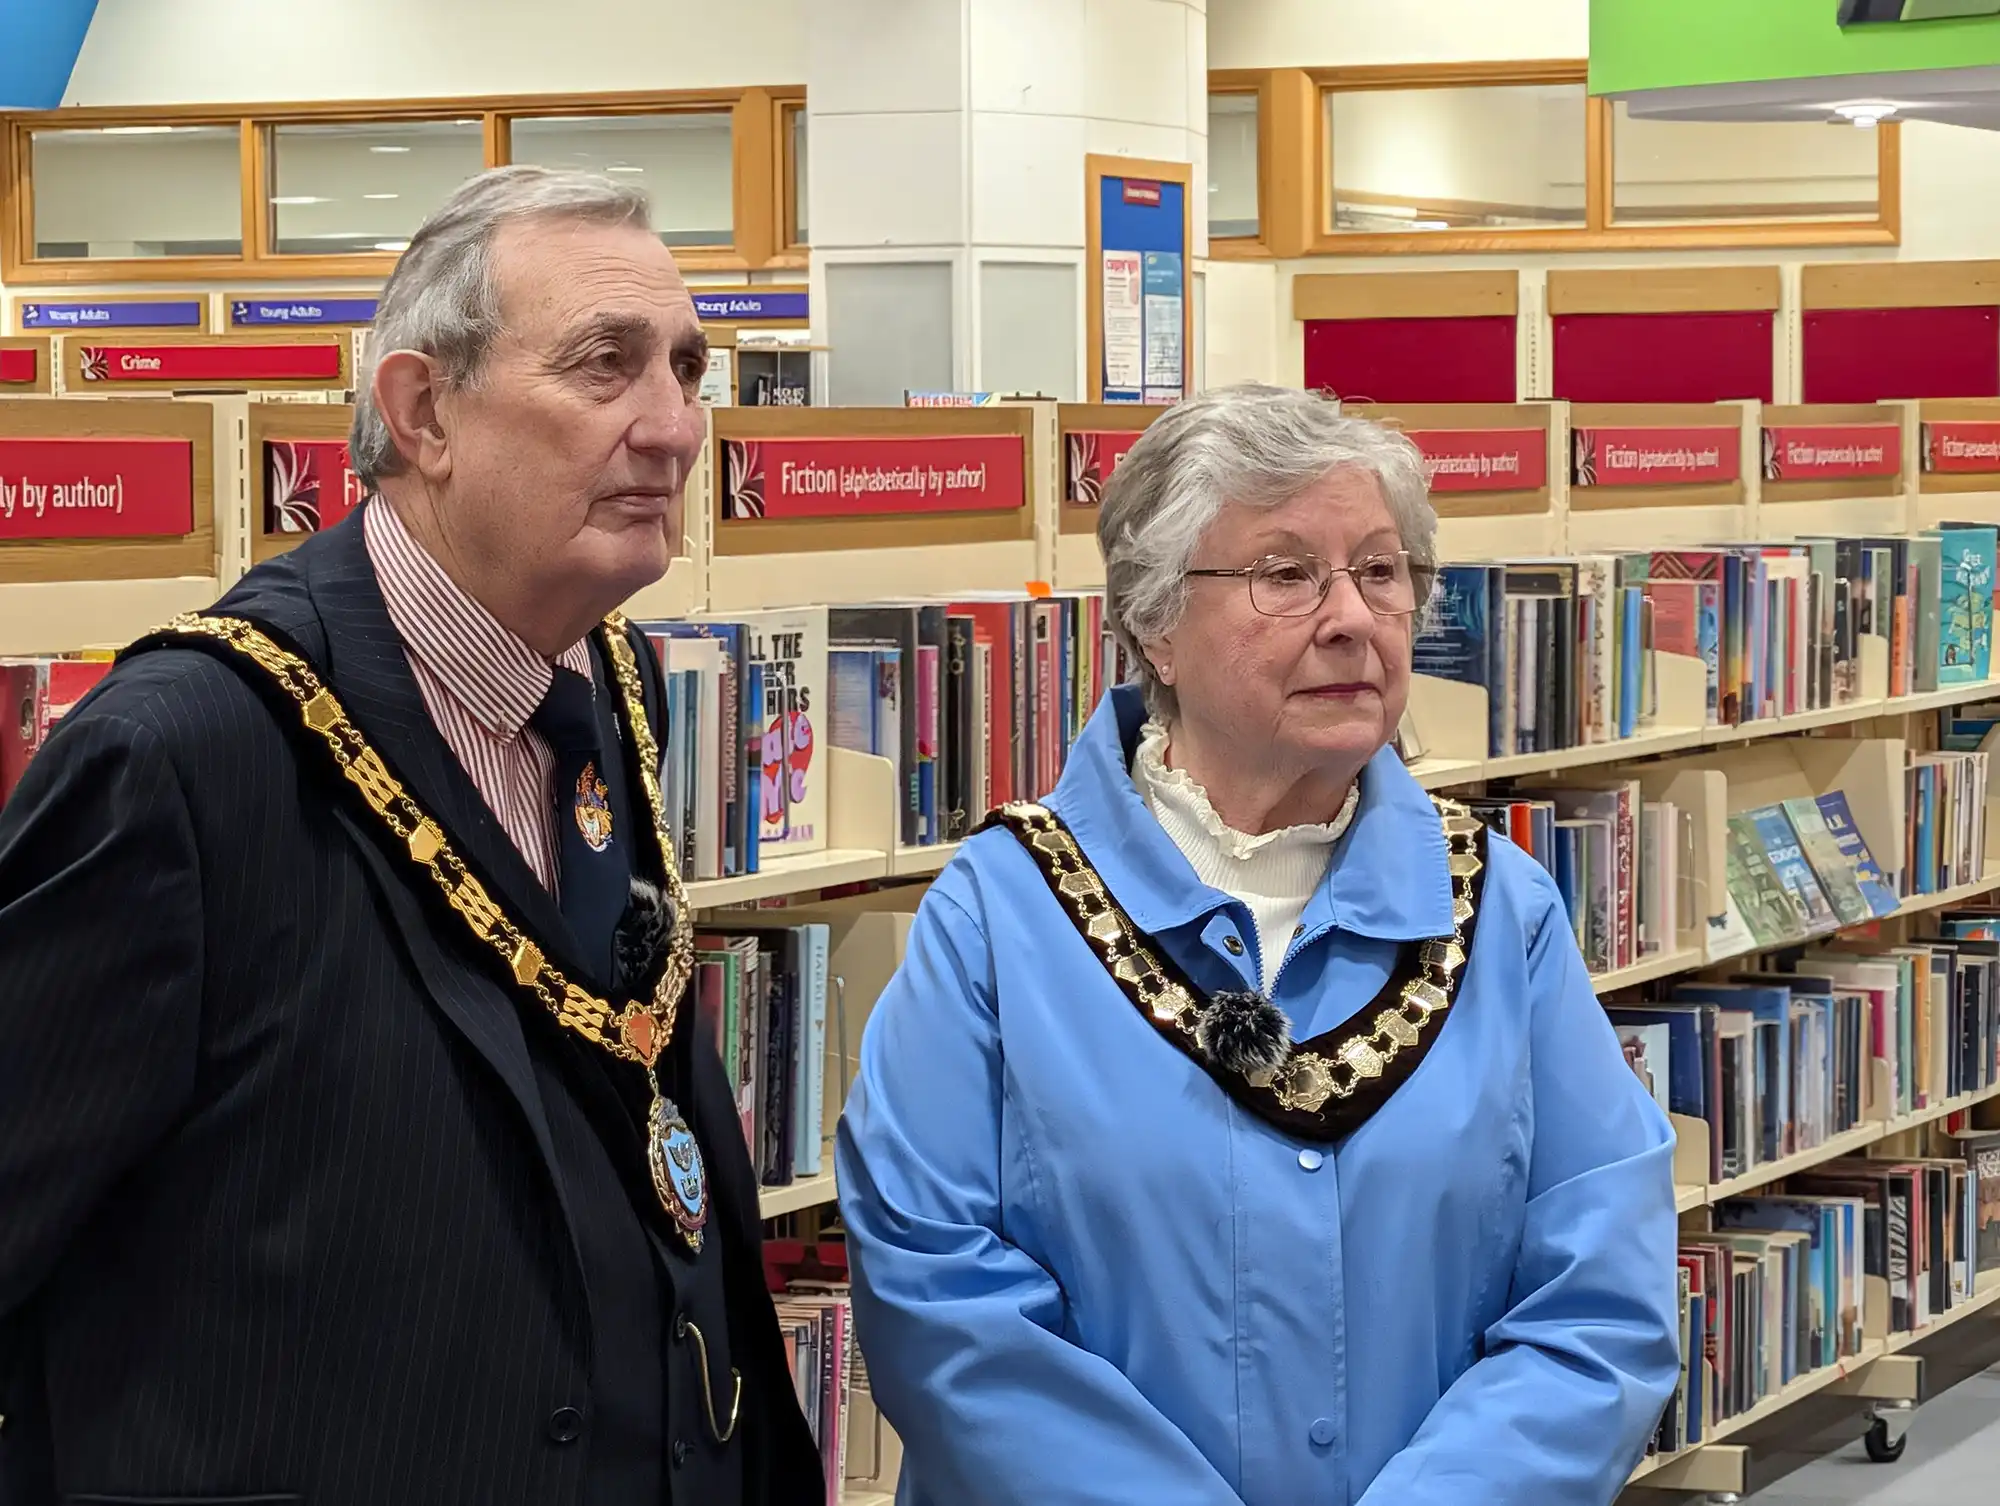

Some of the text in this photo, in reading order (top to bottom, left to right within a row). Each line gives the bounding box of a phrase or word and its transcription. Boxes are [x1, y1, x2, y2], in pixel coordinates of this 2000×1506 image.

[48, 309, 78, 324] Young
[120, 354, 161, 371] Crime
[1605, 443, 1638, 469] Fiction
[781, 460, 986, 499] Fiction (alphabetically by author)
[22, 476, 48, 518] by
[52, 473, 123, 514] author)
[771, 631, 803, 660] THE
